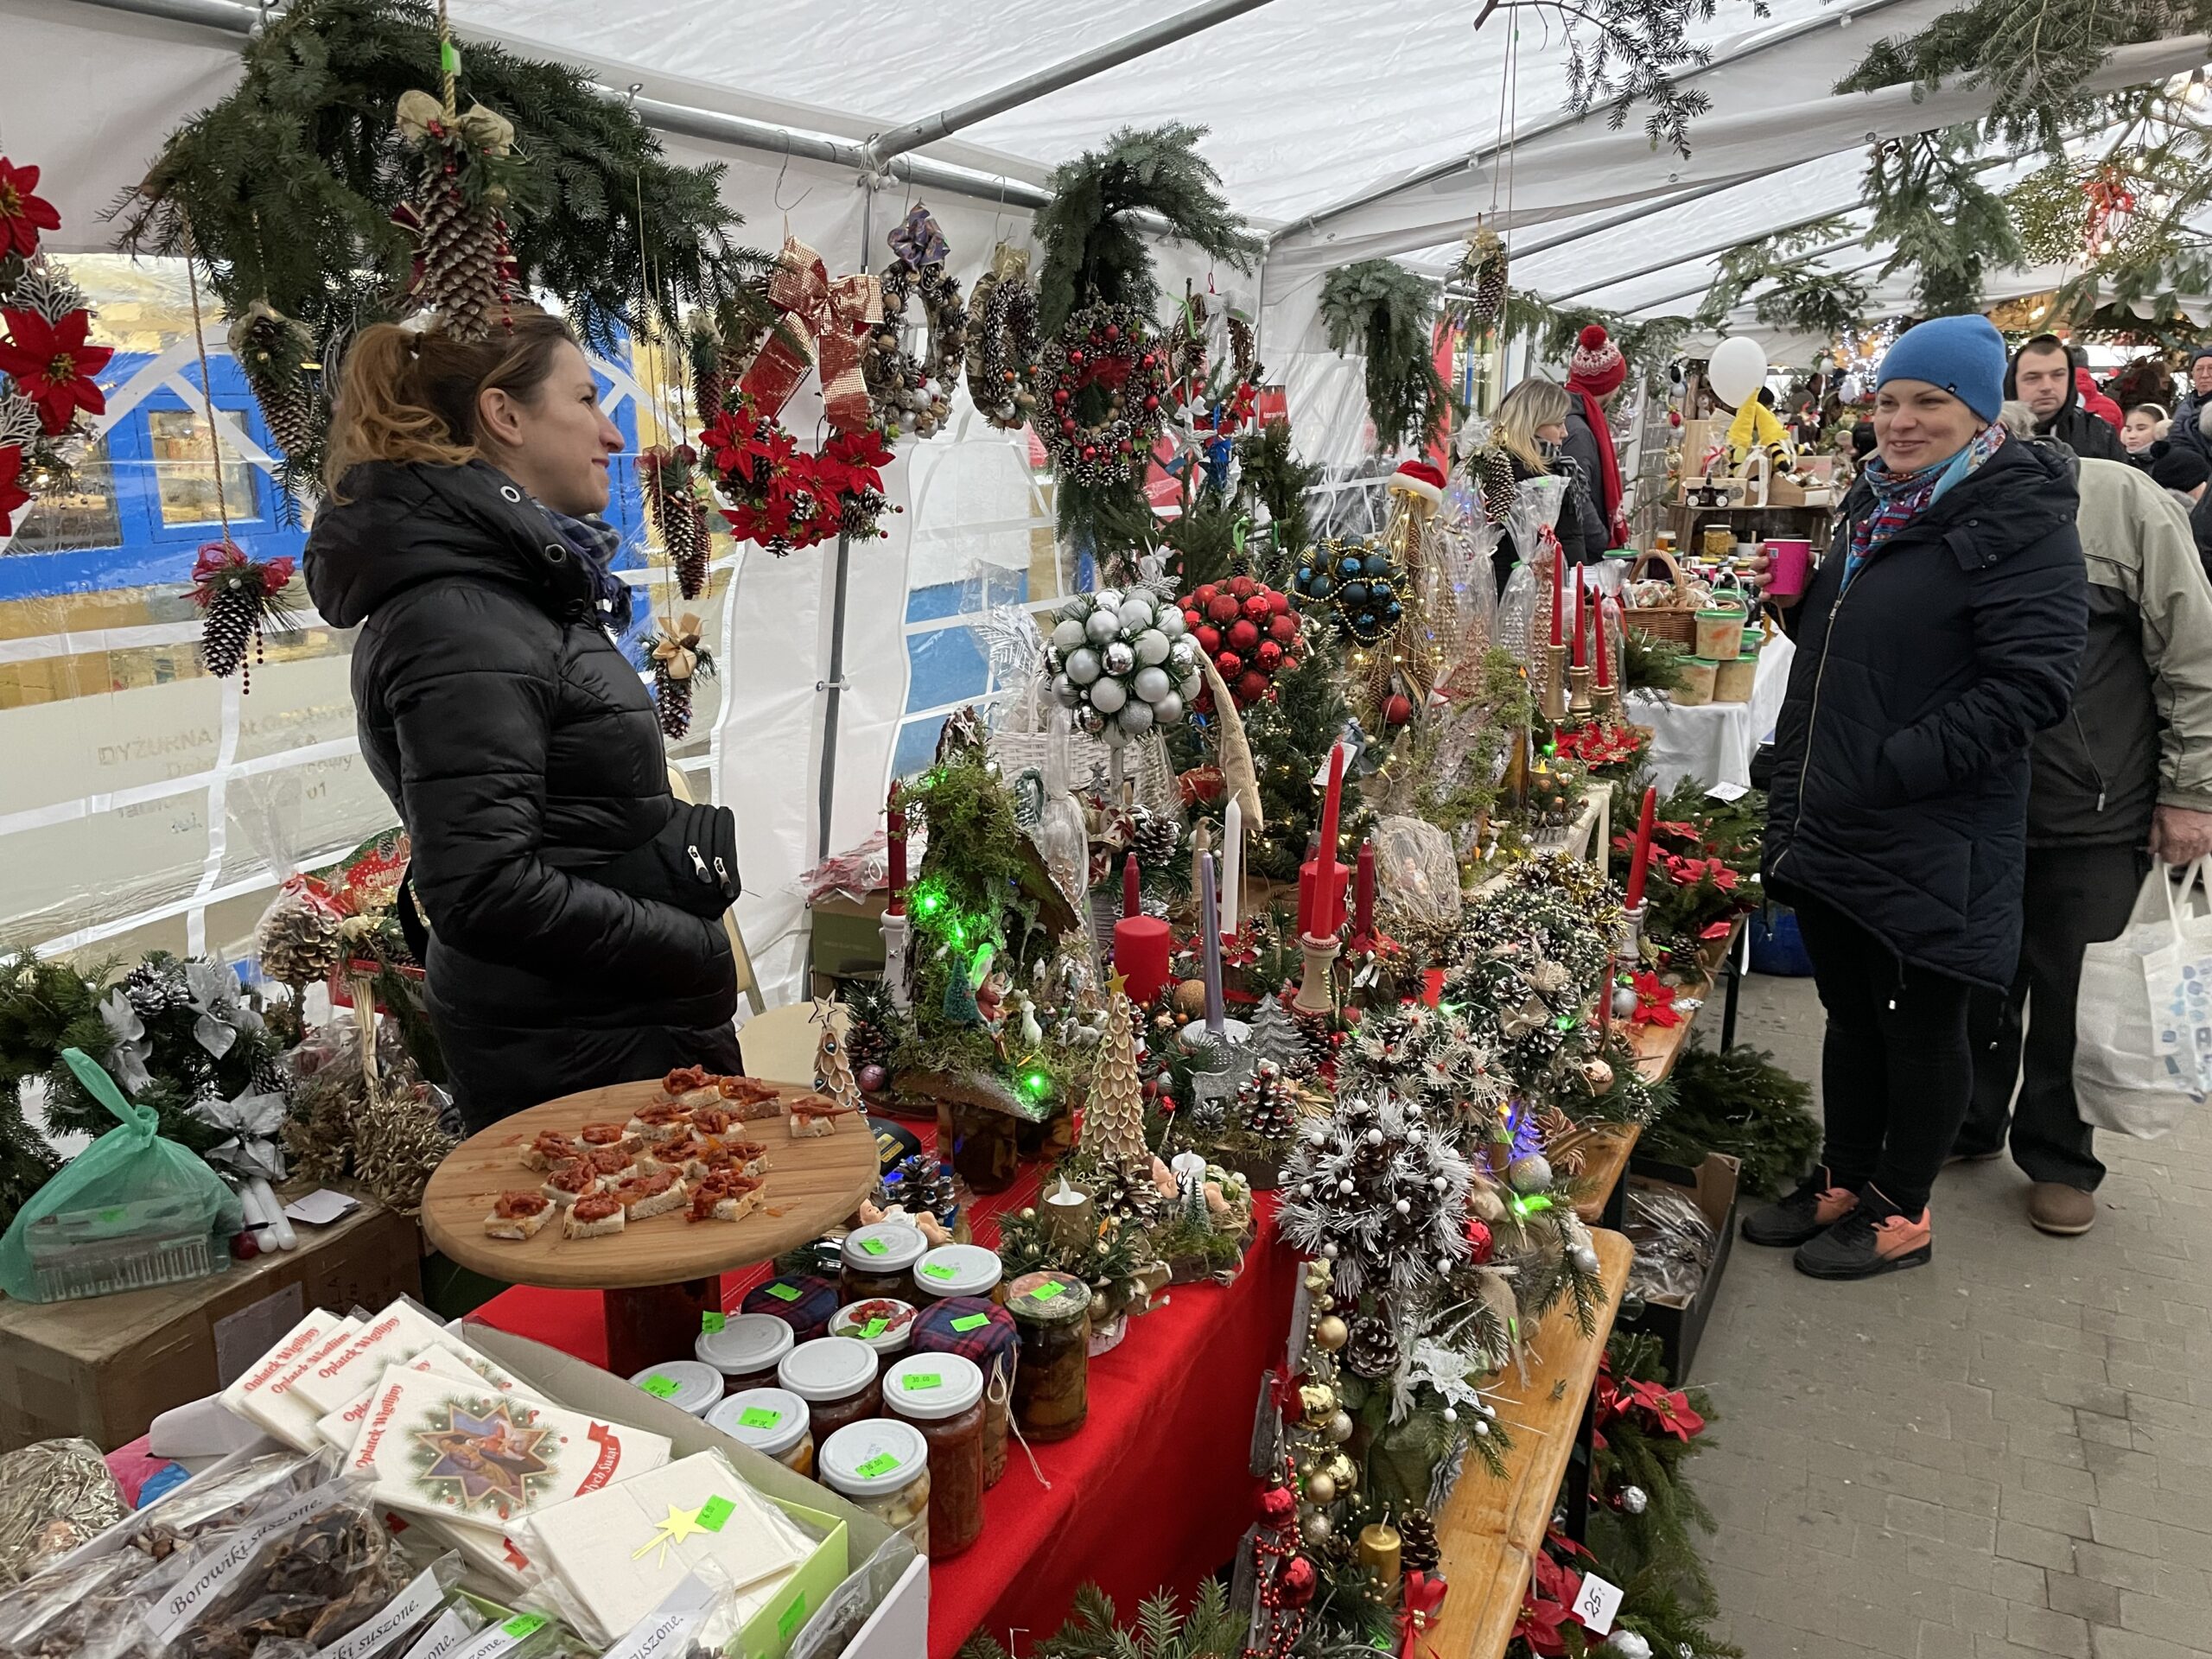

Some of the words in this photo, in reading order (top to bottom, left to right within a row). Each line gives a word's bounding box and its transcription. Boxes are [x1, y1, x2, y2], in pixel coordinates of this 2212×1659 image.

[170, 1540, 249, 1615] Borowiki
[247, 1498, 323, 1550] suszone.
[359, 1601, 419, 1650] suszone.
